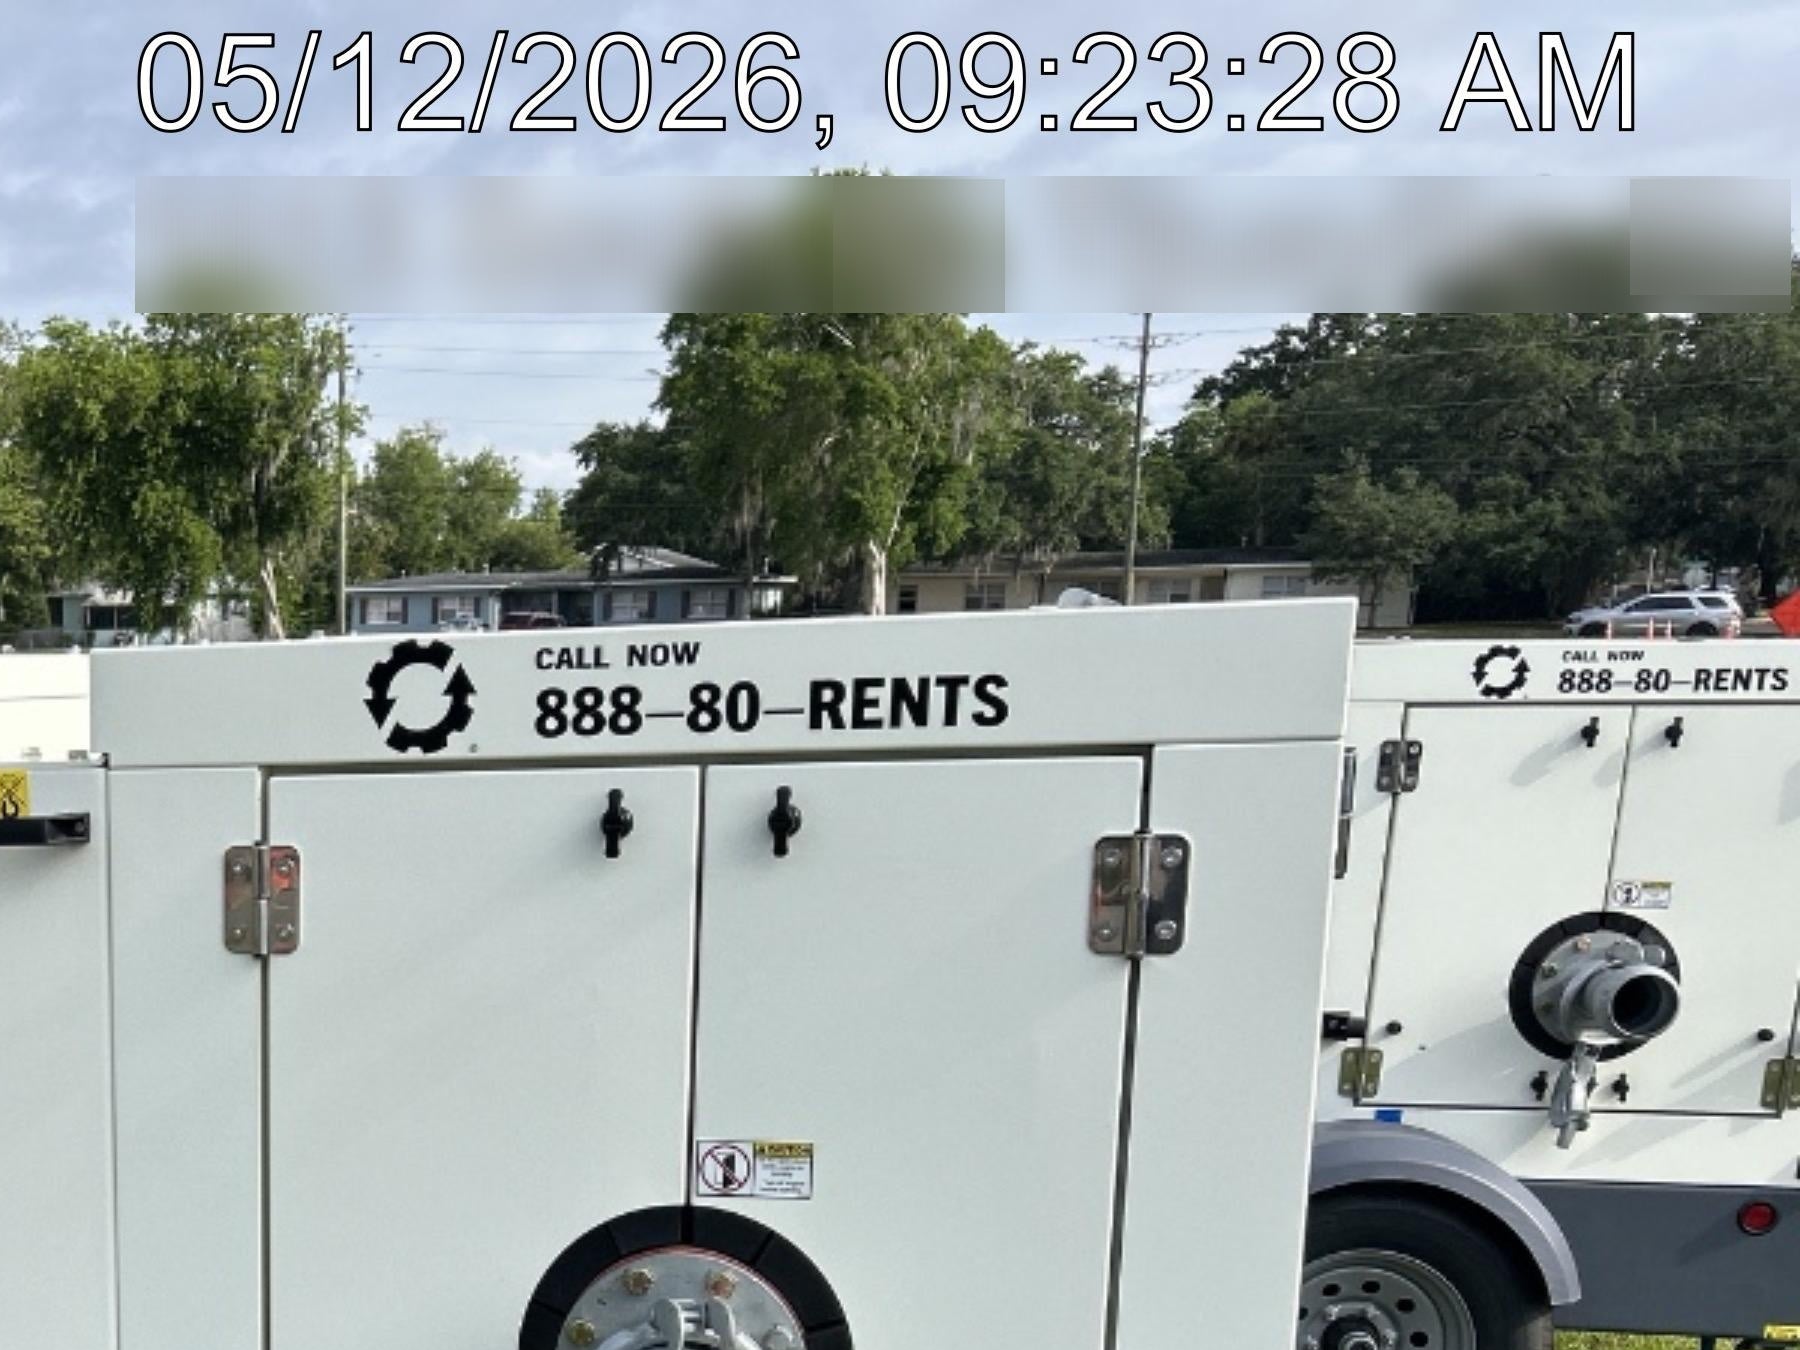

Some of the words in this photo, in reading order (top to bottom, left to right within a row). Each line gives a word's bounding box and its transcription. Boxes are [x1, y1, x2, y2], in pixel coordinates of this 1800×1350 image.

[535, 646, 610, 670] CALL
[627, 641, 701, 667] NOW
[1562, 650, 1599, 663] CALL
[1607, 650, 1645, 662] NOW
[534, 673, 1010, 738] 888-80-RENTS
